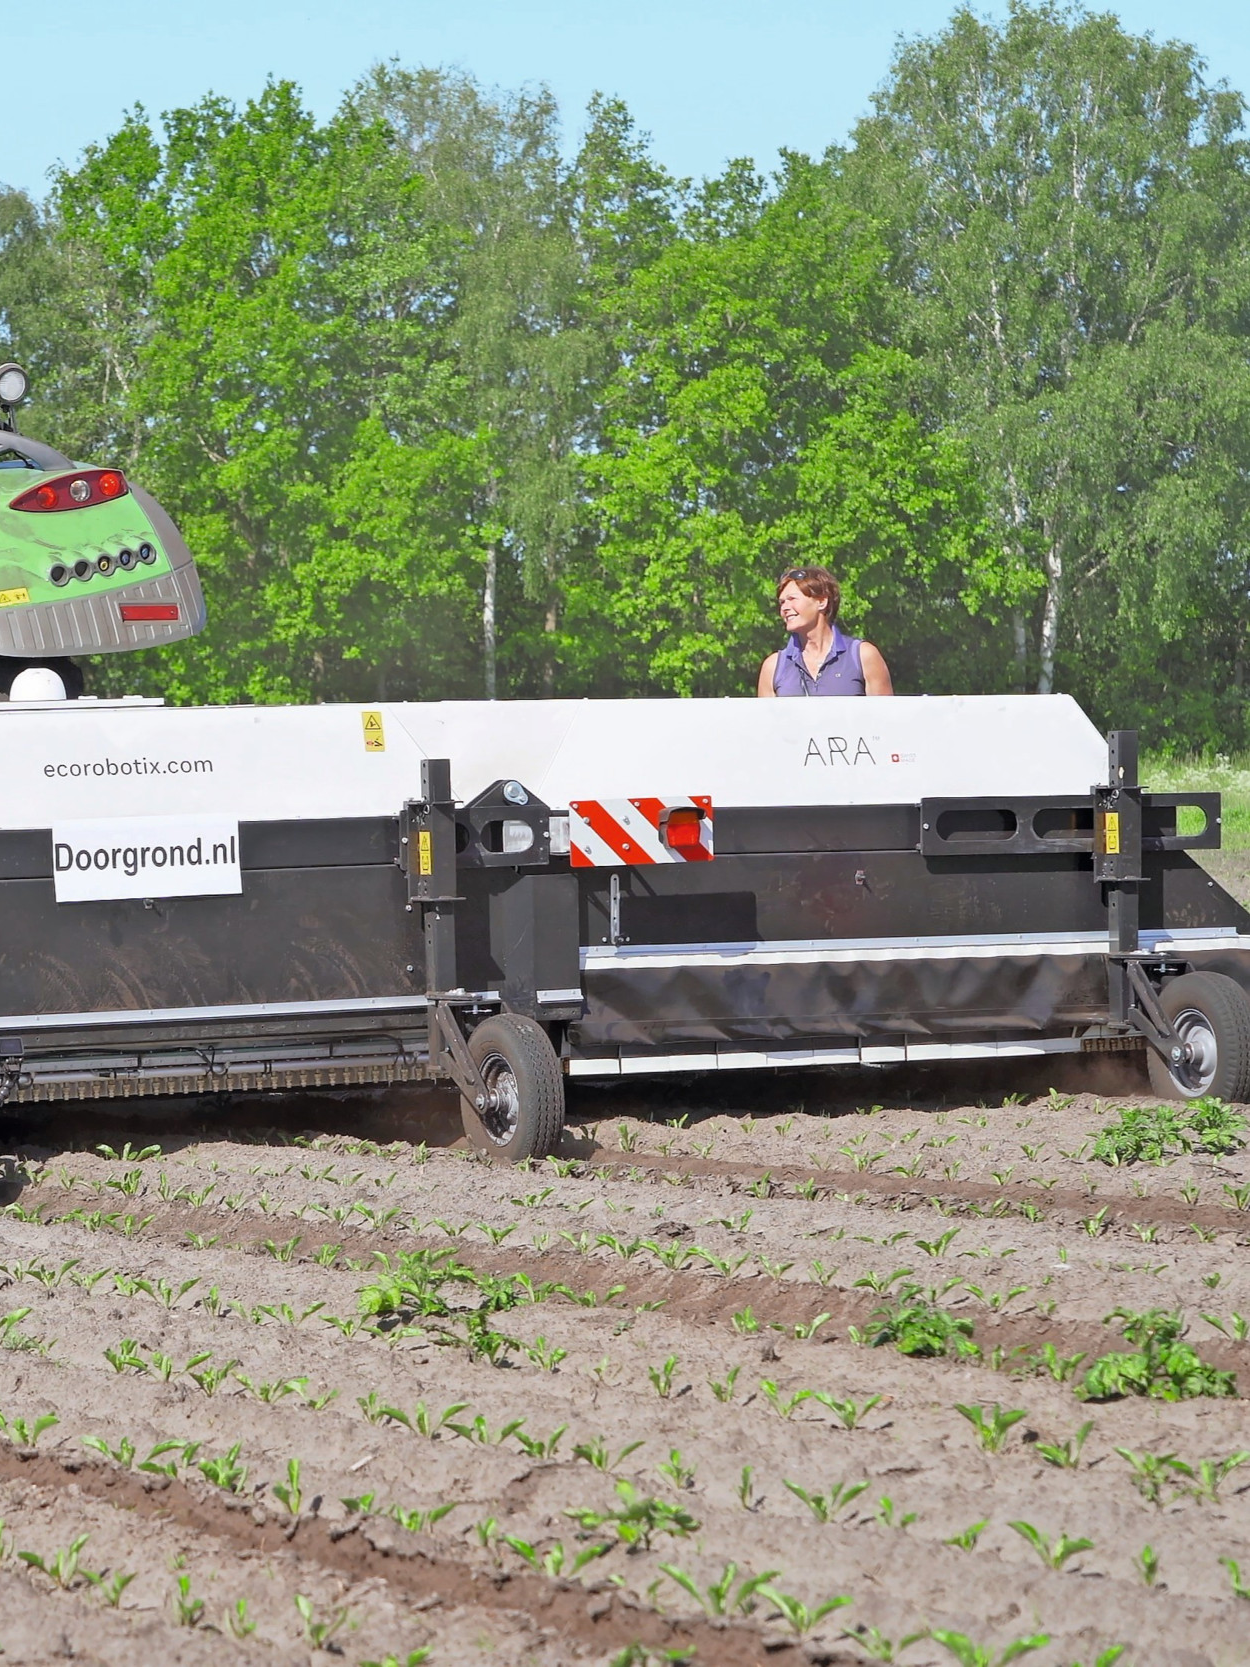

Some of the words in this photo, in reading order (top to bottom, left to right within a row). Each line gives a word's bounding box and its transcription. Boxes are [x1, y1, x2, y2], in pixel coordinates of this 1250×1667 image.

[804, 736, 876, 766] ARA
[43, 757, 214, 777] ecorobotix.com
[54, 835, 236, 877] Doorgrond.nl
